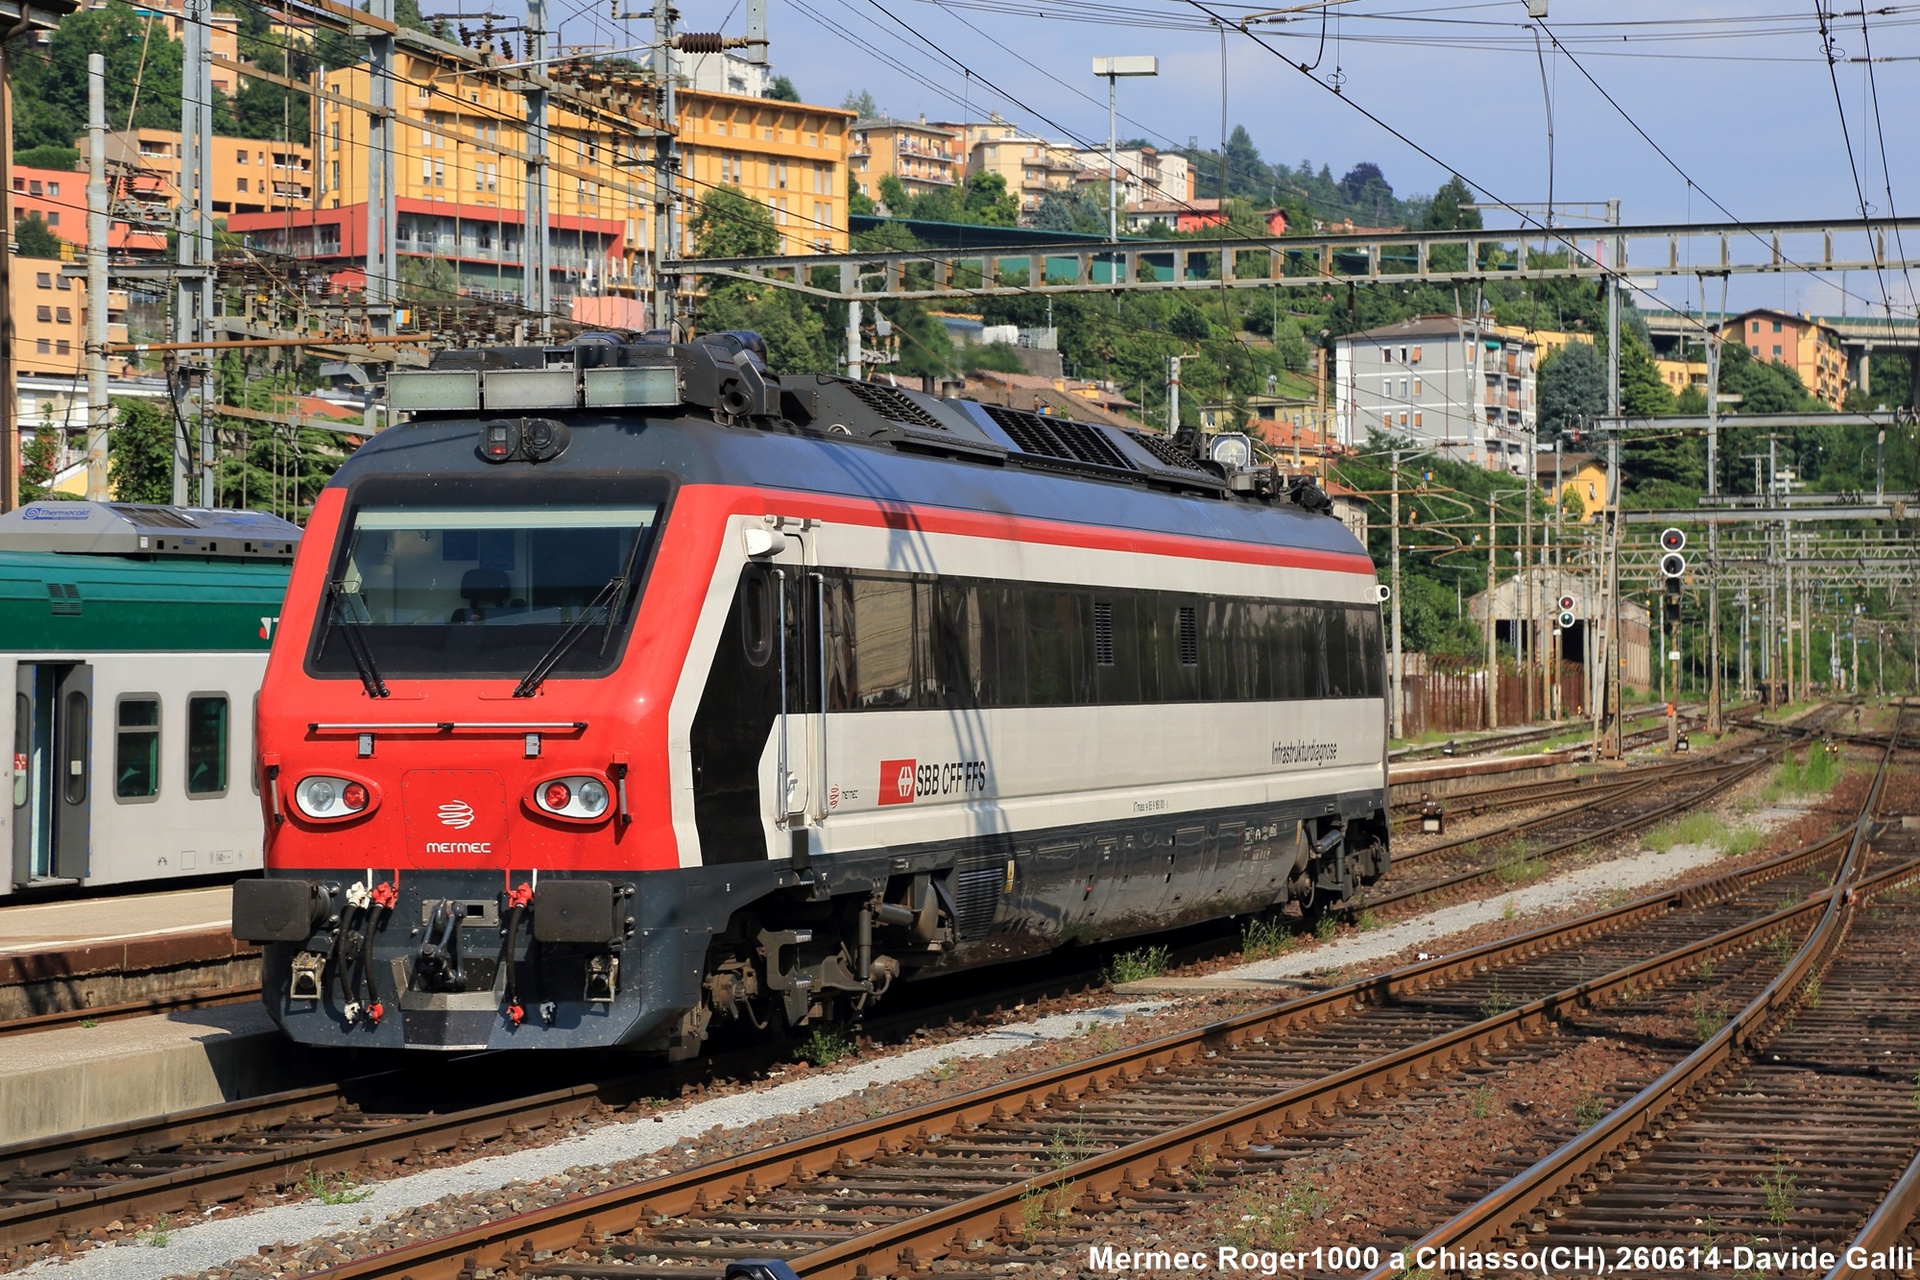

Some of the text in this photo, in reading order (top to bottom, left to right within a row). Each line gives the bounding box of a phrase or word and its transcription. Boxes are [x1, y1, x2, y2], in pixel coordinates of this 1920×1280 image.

[1271, 739, 1337, 766] Infrastrukturdiagnose
[916, 761, 986, 797] SBB CFF FFS
